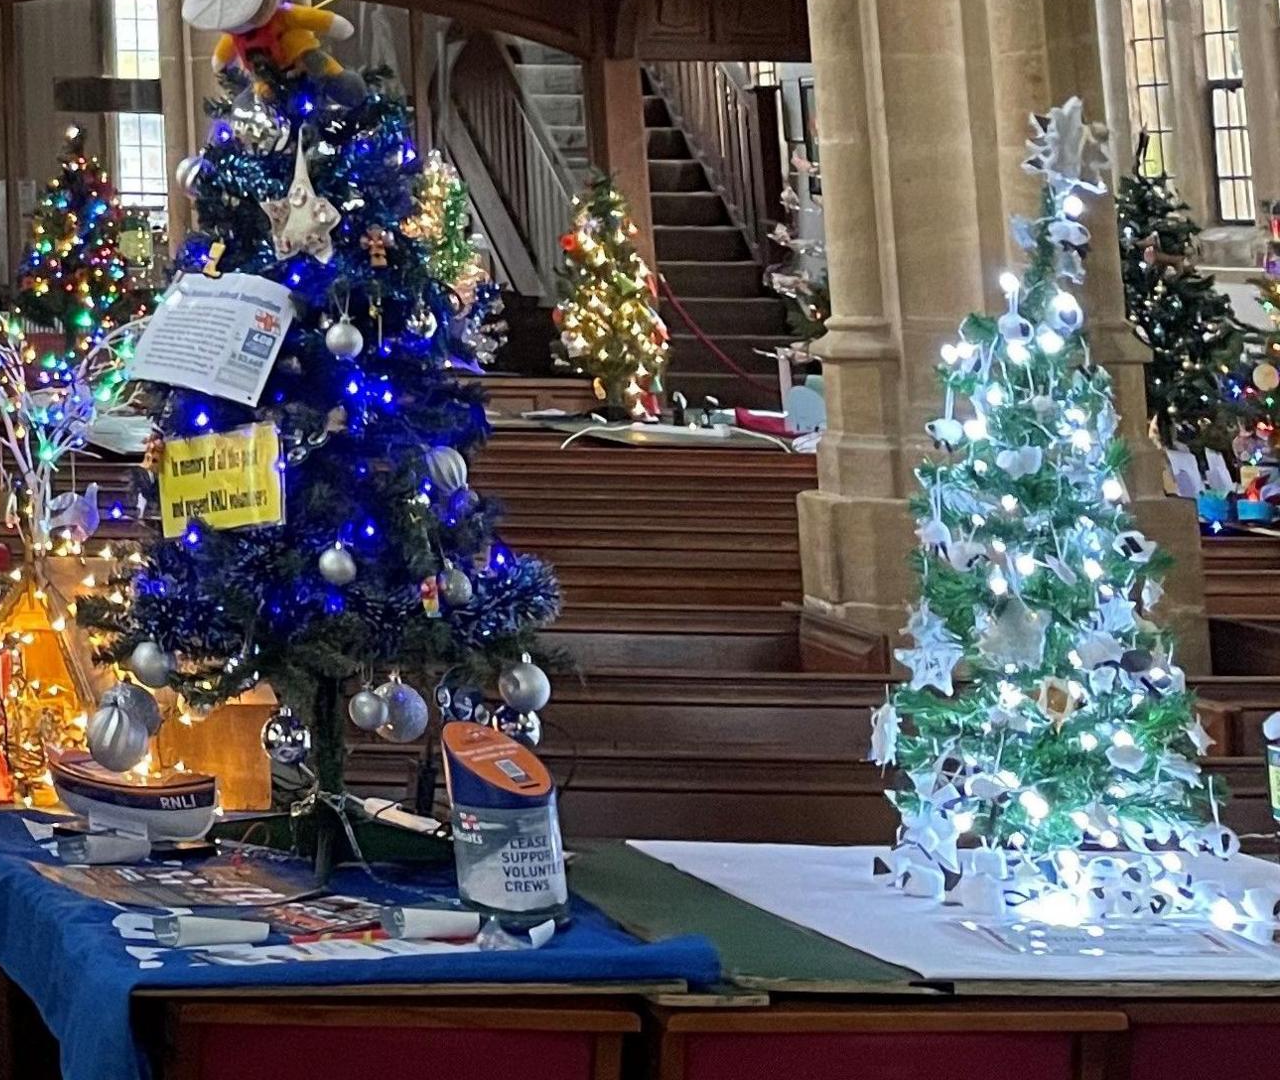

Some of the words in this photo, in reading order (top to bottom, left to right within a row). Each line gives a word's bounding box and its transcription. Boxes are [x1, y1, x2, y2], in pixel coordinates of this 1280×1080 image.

[160, 794, 196, 809] RNLI
[509, 836, 547, 849] LEASE
[501, 849, 551, 863] SUPPOR
[504, 879, 550, 893] CREWS
